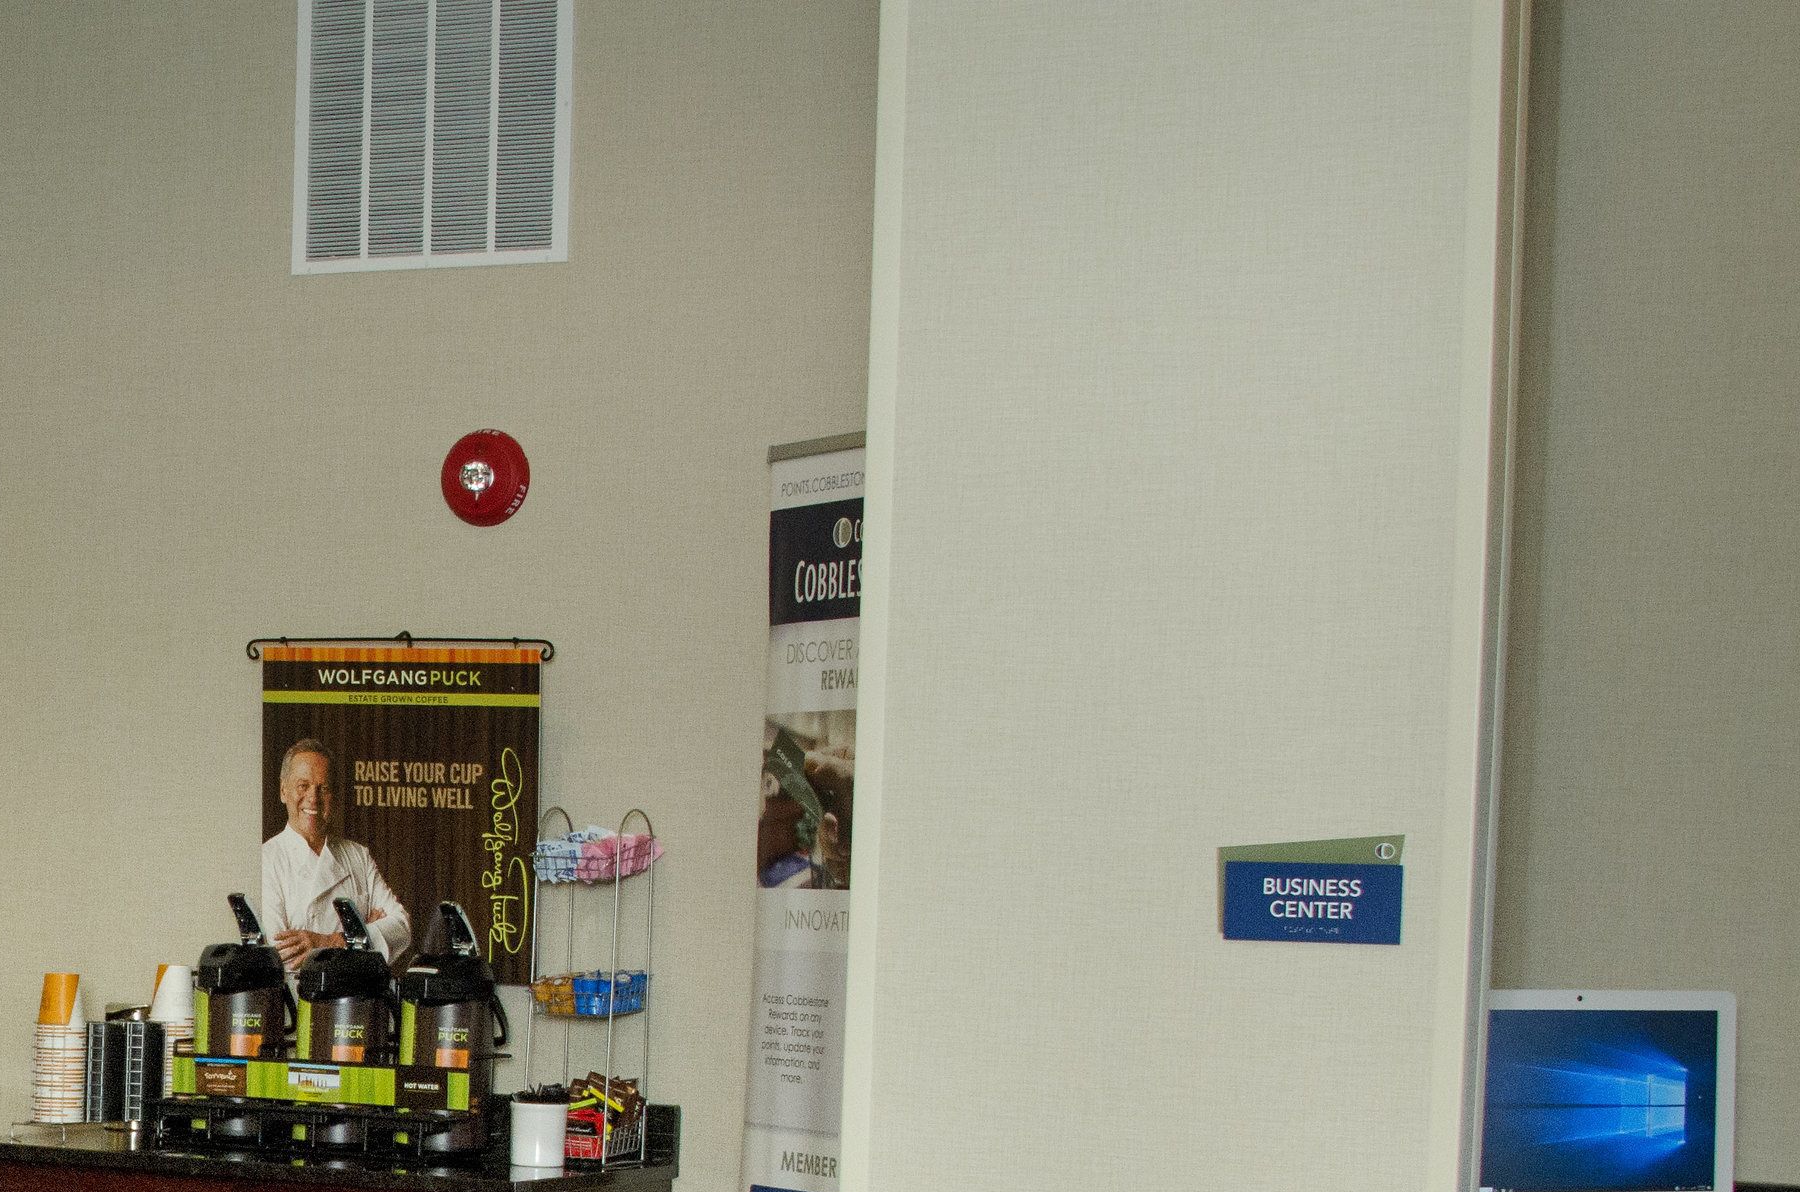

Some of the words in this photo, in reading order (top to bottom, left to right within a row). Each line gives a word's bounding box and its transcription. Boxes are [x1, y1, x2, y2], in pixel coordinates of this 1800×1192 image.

[505, 484, 527, 515] FIRE
[786, 639, 853, 664] DISCOVER
[380, 695, 412, 703] GROWN
[415, 696, 448, 704] COFFEE
[355, 760, 399, 782] RAISE
[403, 761, 446, 784] YOUR
[450, 762, 483, 785] CUP
[354, 785, 373, 806] TO
[377, 786, 428, 808] LIVING
[431, 787, 474, 809] WELL
[1263, 877, 1362, 898] BUSINESS
[1269, 900, 1353, 920] CENTER
[232, 1018, 262, 1027] PUCK
[334, 1029, 364, 1039] PUCK
[438, 1032, 468, 1042] PUCK
[781, 1150, 837, 1178] MEMBER
